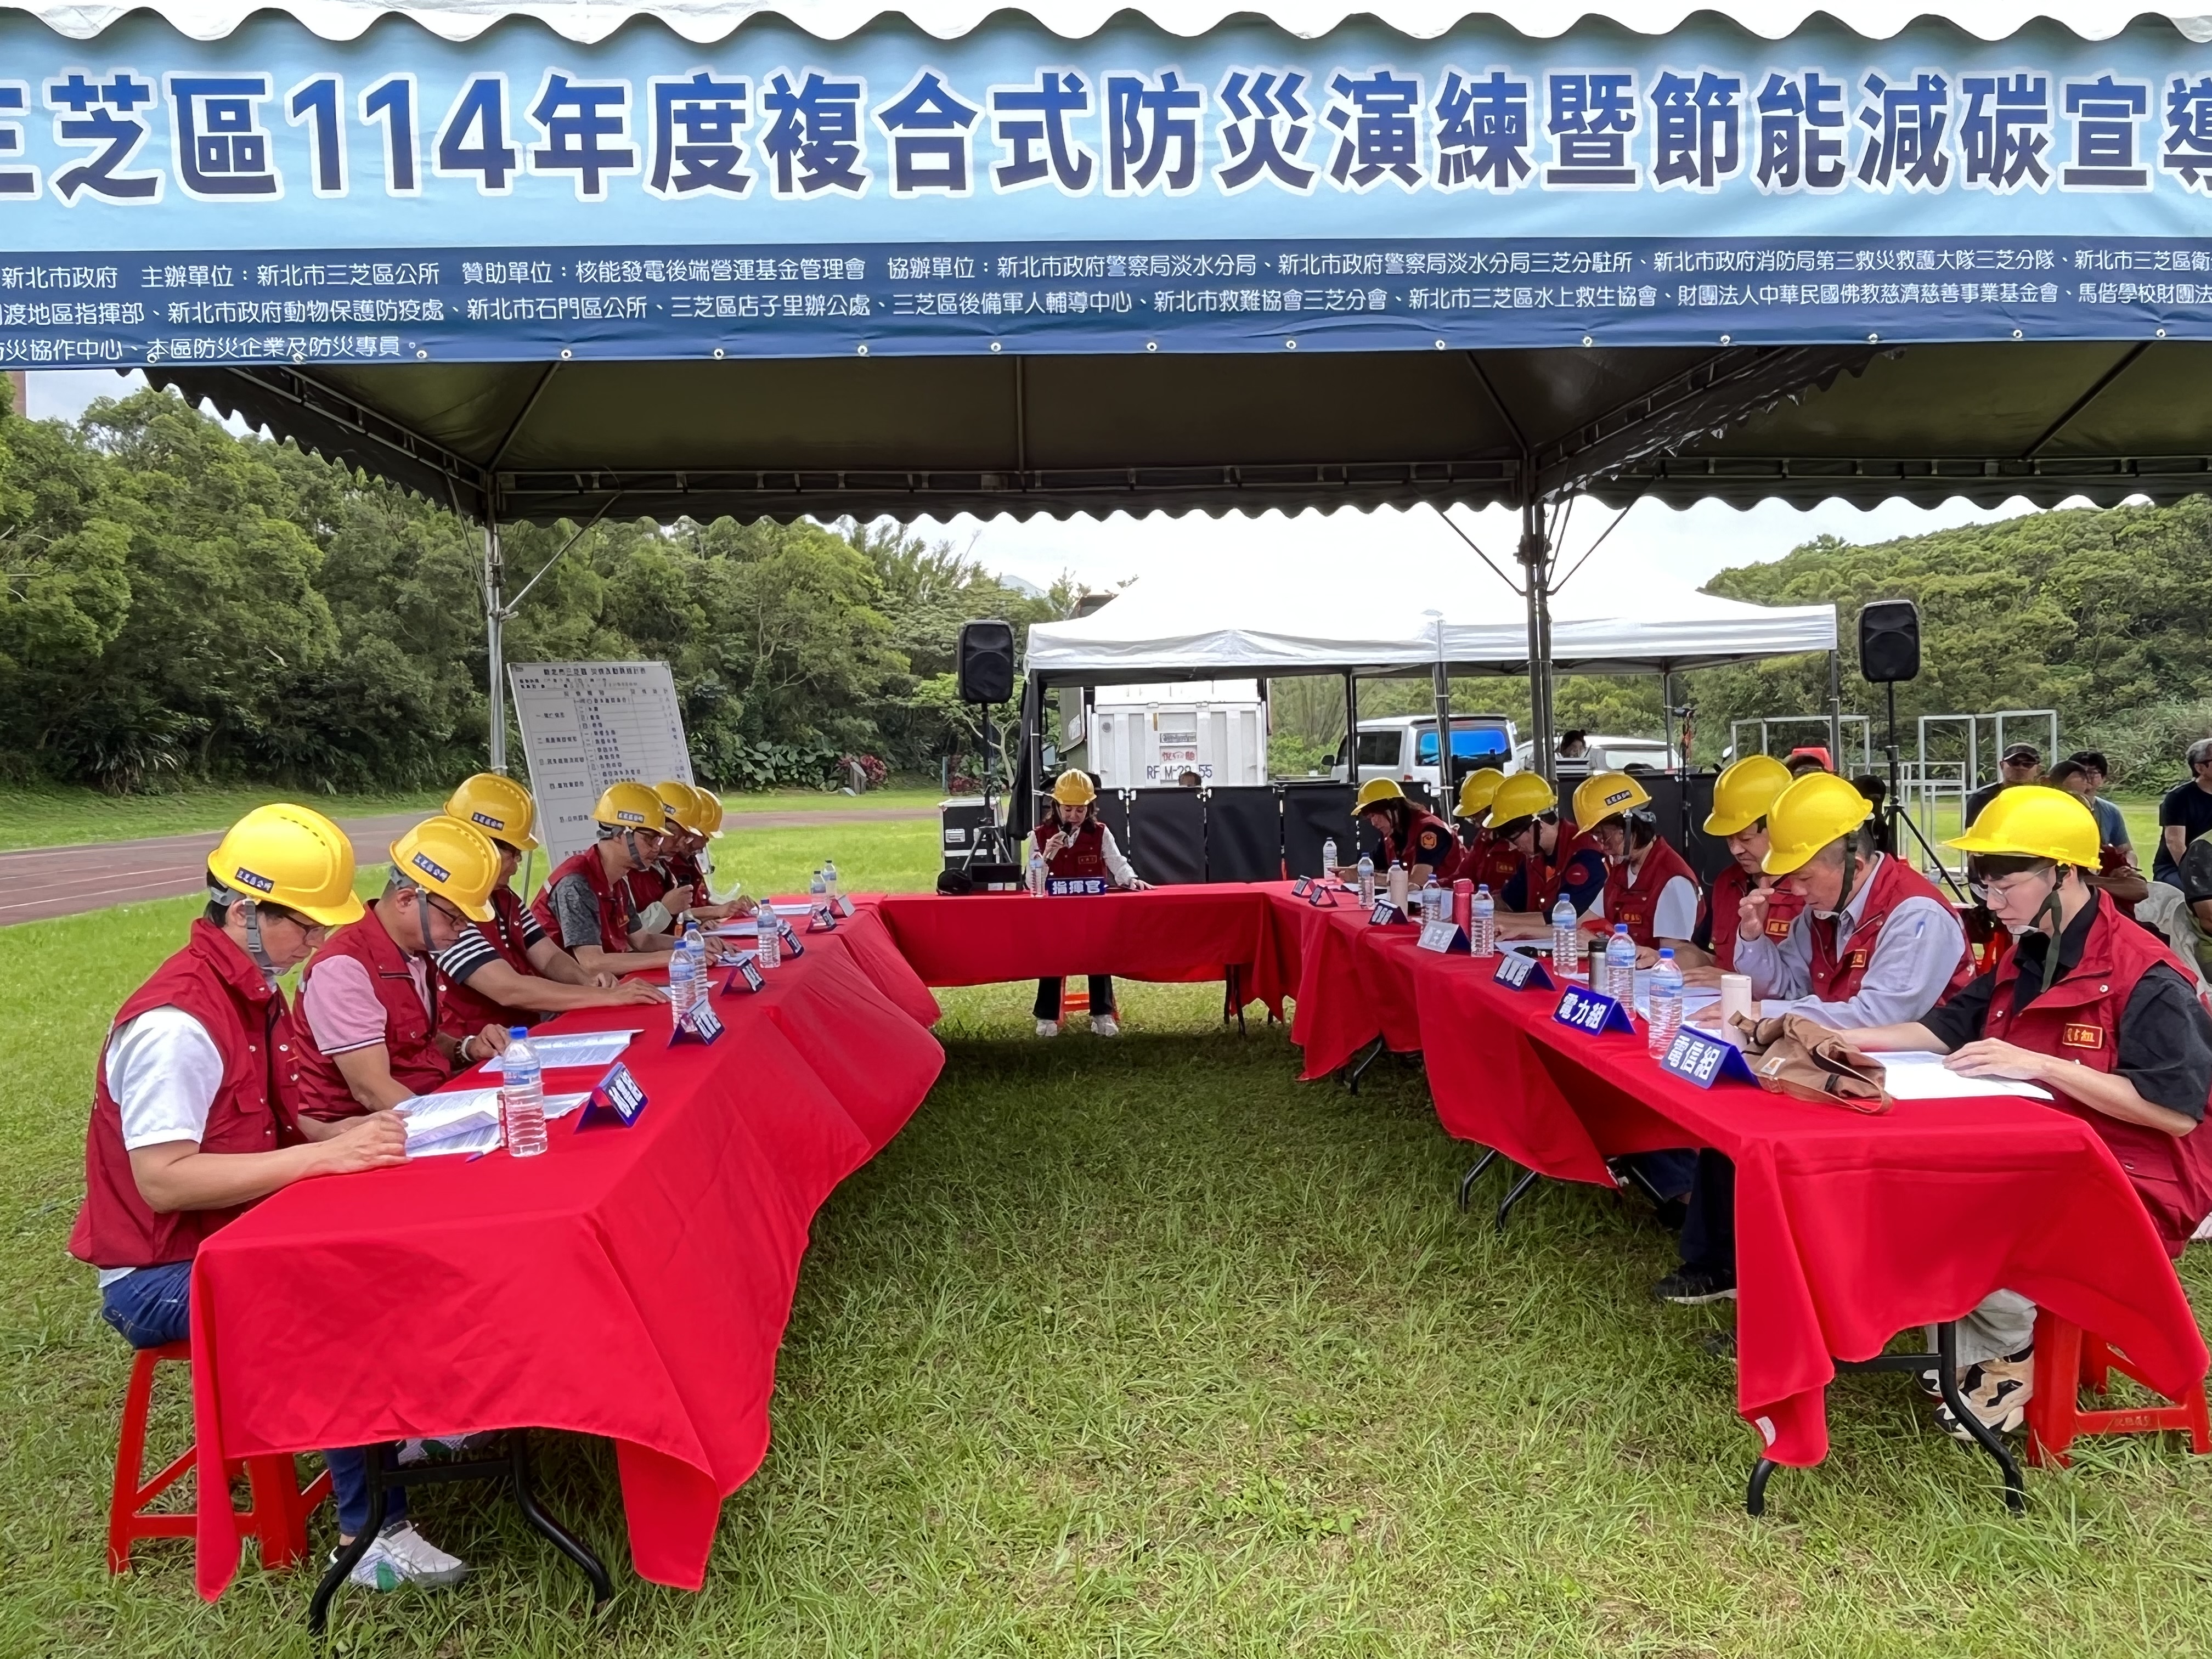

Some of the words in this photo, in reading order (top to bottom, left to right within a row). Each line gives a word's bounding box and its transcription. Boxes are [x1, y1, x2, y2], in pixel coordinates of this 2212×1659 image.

[2, 266, 117, 289] 新北市政府
[1052, 880, 1101, 894] 指揮官
[1559, 993, 1607, 1029] 電力組
[1668, 1035, 1720, 1080] 電信組
